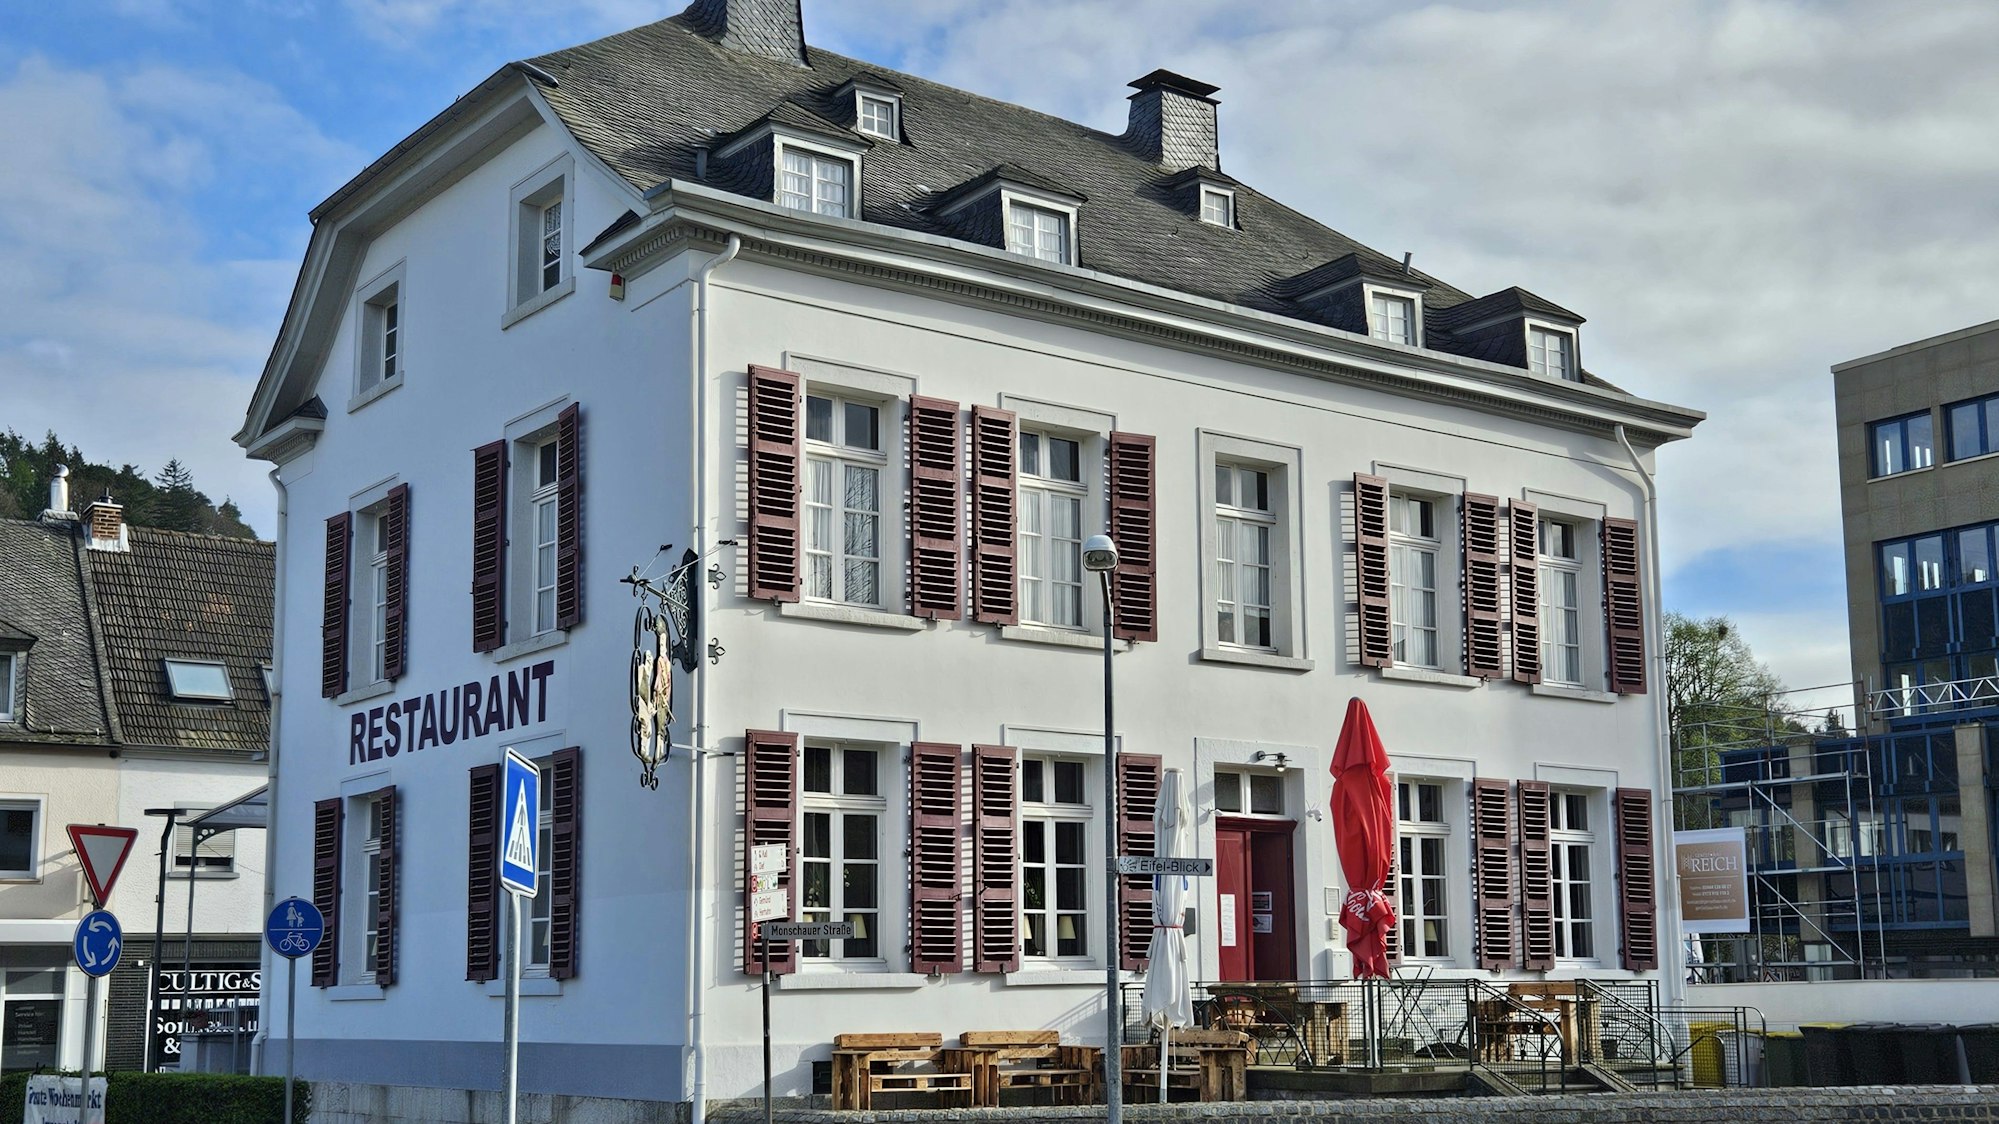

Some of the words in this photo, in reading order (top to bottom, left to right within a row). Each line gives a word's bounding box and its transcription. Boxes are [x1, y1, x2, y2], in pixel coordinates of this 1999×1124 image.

[350, 660, 554, 765] RESTAURANT
[1140, 860, 1199, 873] Eifel-Blick
[1691, 855, 1738, 872] REICH
[771, 924, 821, 936] Monschauer
[823, 924, 851, 935] Straße
